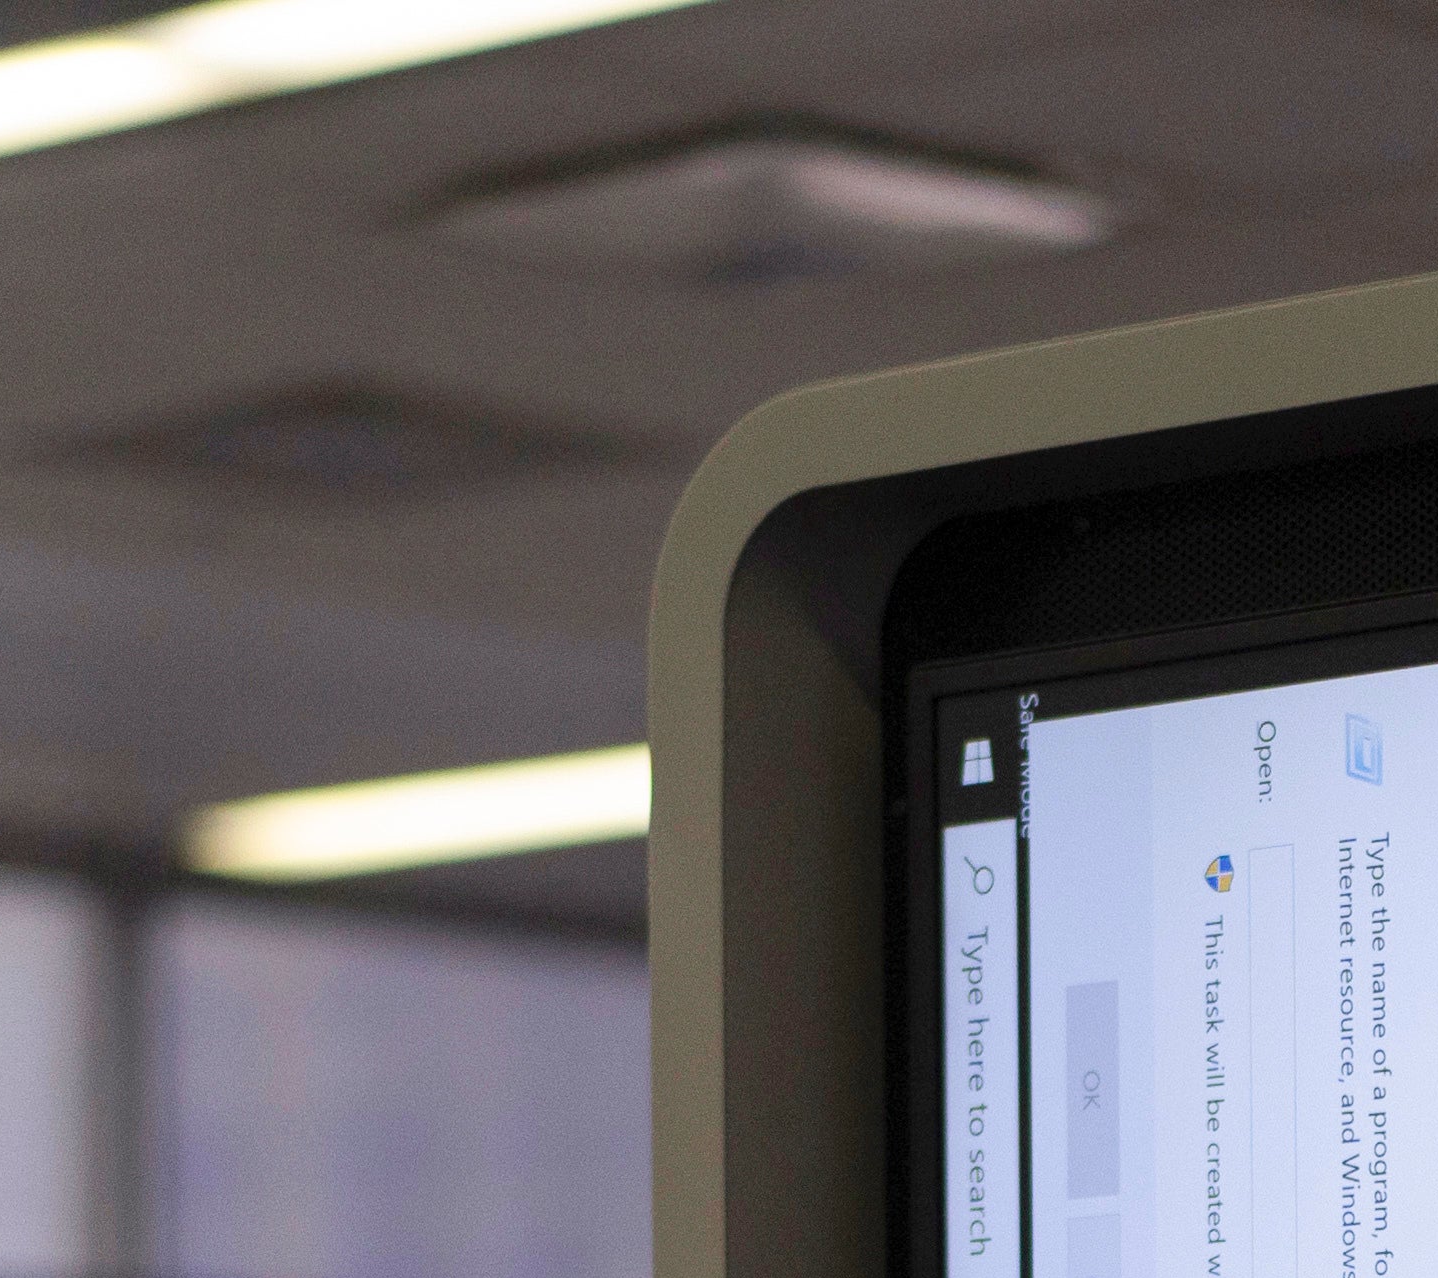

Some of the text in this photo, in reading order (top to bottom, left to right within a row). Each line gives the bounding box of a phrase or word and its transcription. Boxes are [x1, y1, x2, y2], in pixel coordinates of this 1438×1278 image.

[1252, 719, 1278, 804] Open:
[1337, 836, 1358, 948] Internet
[1364, 830, 1391, 899] Type
[1204, 913, 1225, 971] This
[1370, 905, 1392, 953] the
[1204, 978, 1226, 1035] task
[1337, 956, 1355, 1084] resource,
[1371, 961, 1387, 1040] name
[1082, 1069, 1103, 1112] OK
[1205, 1041, 1226, 1089] will
[1371, 1047, 1394, 1077] of
[960, 927, 994, 1257] Type here to search
[1205, 1097, 1226, 1133] be
[1339, 1092, 1362, 1145] and
[1372, 1085, 1388, 1102] a
[1205, 1141, 1227, 1246] created
[1367, 1110, 1389, 1239] program,
